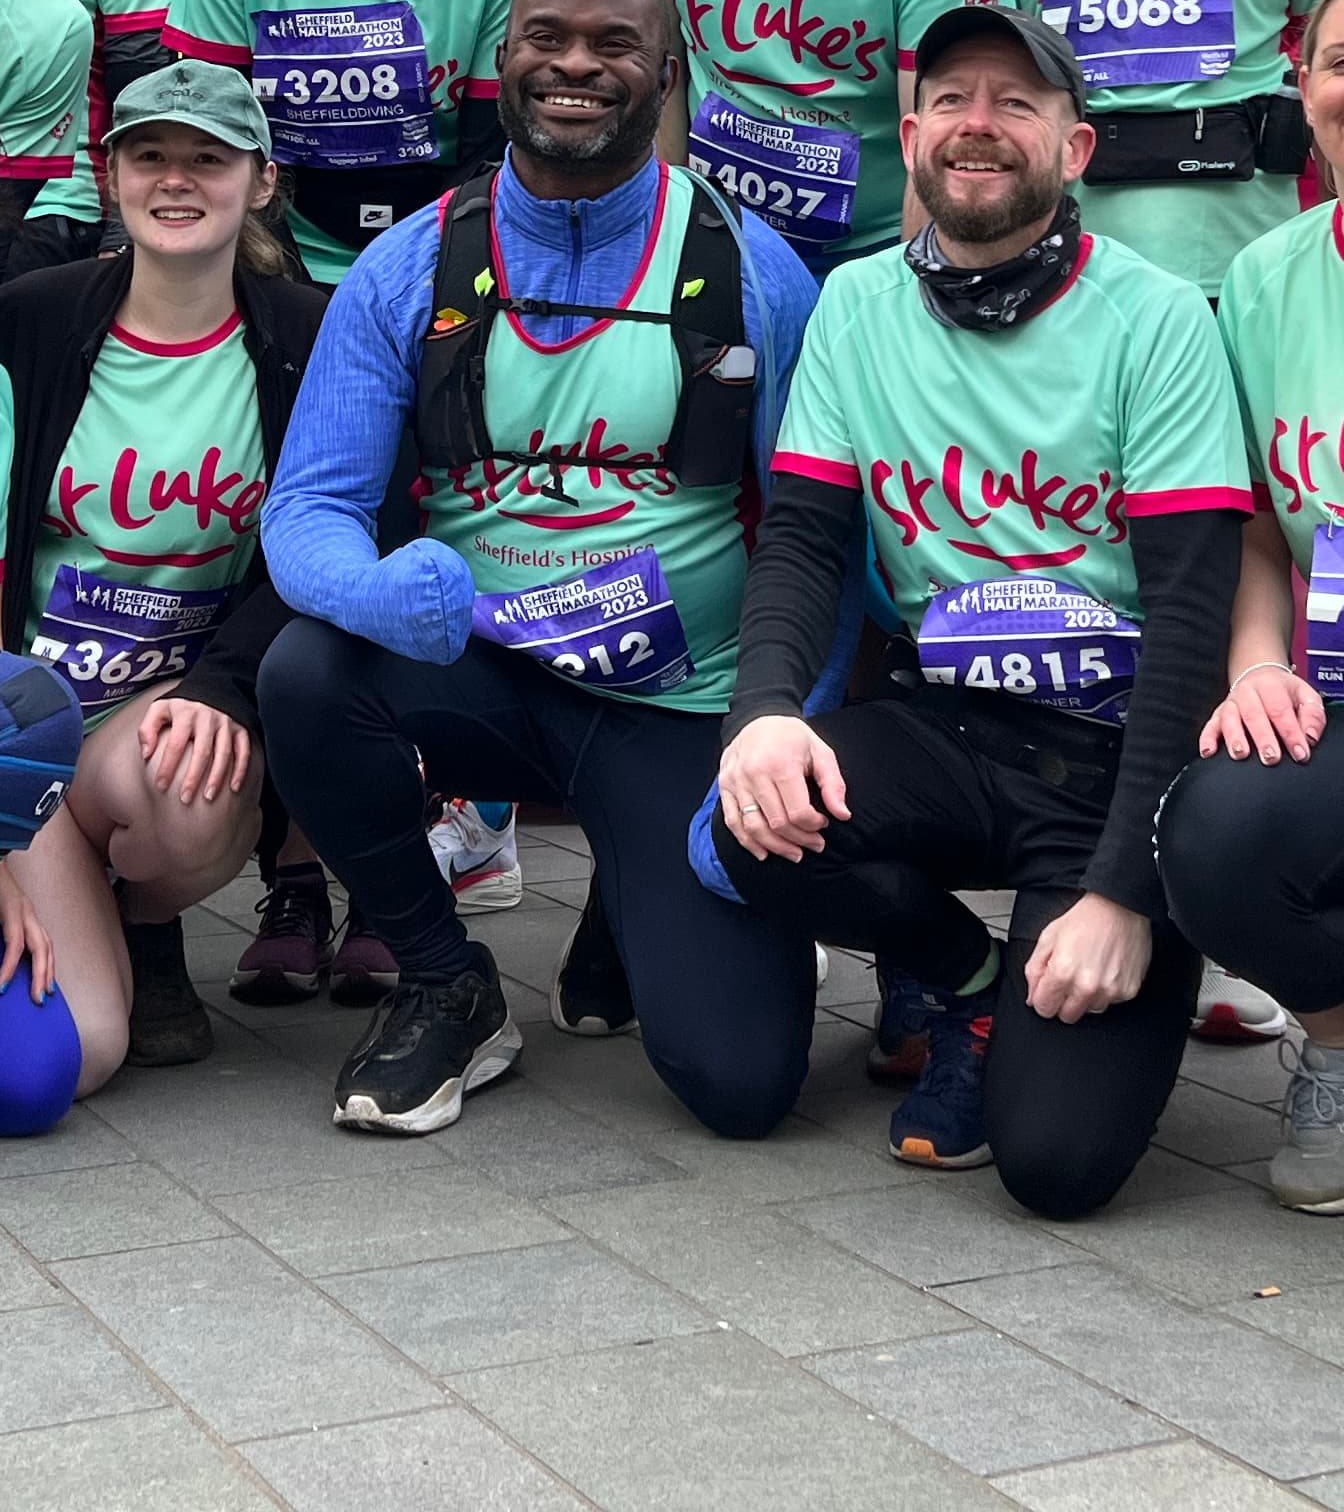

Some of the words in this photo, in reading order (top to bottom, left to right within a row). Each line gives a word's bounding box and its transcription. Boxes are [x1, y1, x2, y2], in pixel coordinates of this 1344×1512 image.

[297, 14, 353, 27] SHEFFIELD
[298, 25, 329, 37] HALF
[330, 20, 401, 35] MARATHON
[362, 33, 405, 49] 2023
[283, 64, 400, 105] 3208
[286, 103, 405, 121] SHEFFIELDDIVING
[737, 117, 790, 139] SHEFFIELD
[398, 142, 433, 158] 3208
[765, 138, 840, 158] MARATHON
[795, 156, 839, 175] 2023
[716, 163, 826, 220] 4027
[941, 445, 1127, 544] Luke's
[474, 535, 565, 567] Sheffield's
[524, 583, 584, 607] SHEFFIELD
[986, 583, 1053, 596] SHEFFIELD
[117, 590, 180, 608] SHEFFIELD
[527, 604, 559, 622] HALF
[562, 576, 640, 613] MARATHON
[600, 591, 648, 619] 2023
[984, 597, 1021, 612] HALF
[1024, 596, 1112, 610] MARATHO
[113, 602, 147, 616] HALF
[174, 615, 213, 632] 2023
[1064, 610, 1118, 628] 2023
[67, 640, 187, 684] 3625
[964, 647, 1112, 694] 4815
[1318, 671, 1343, 681] RUN
